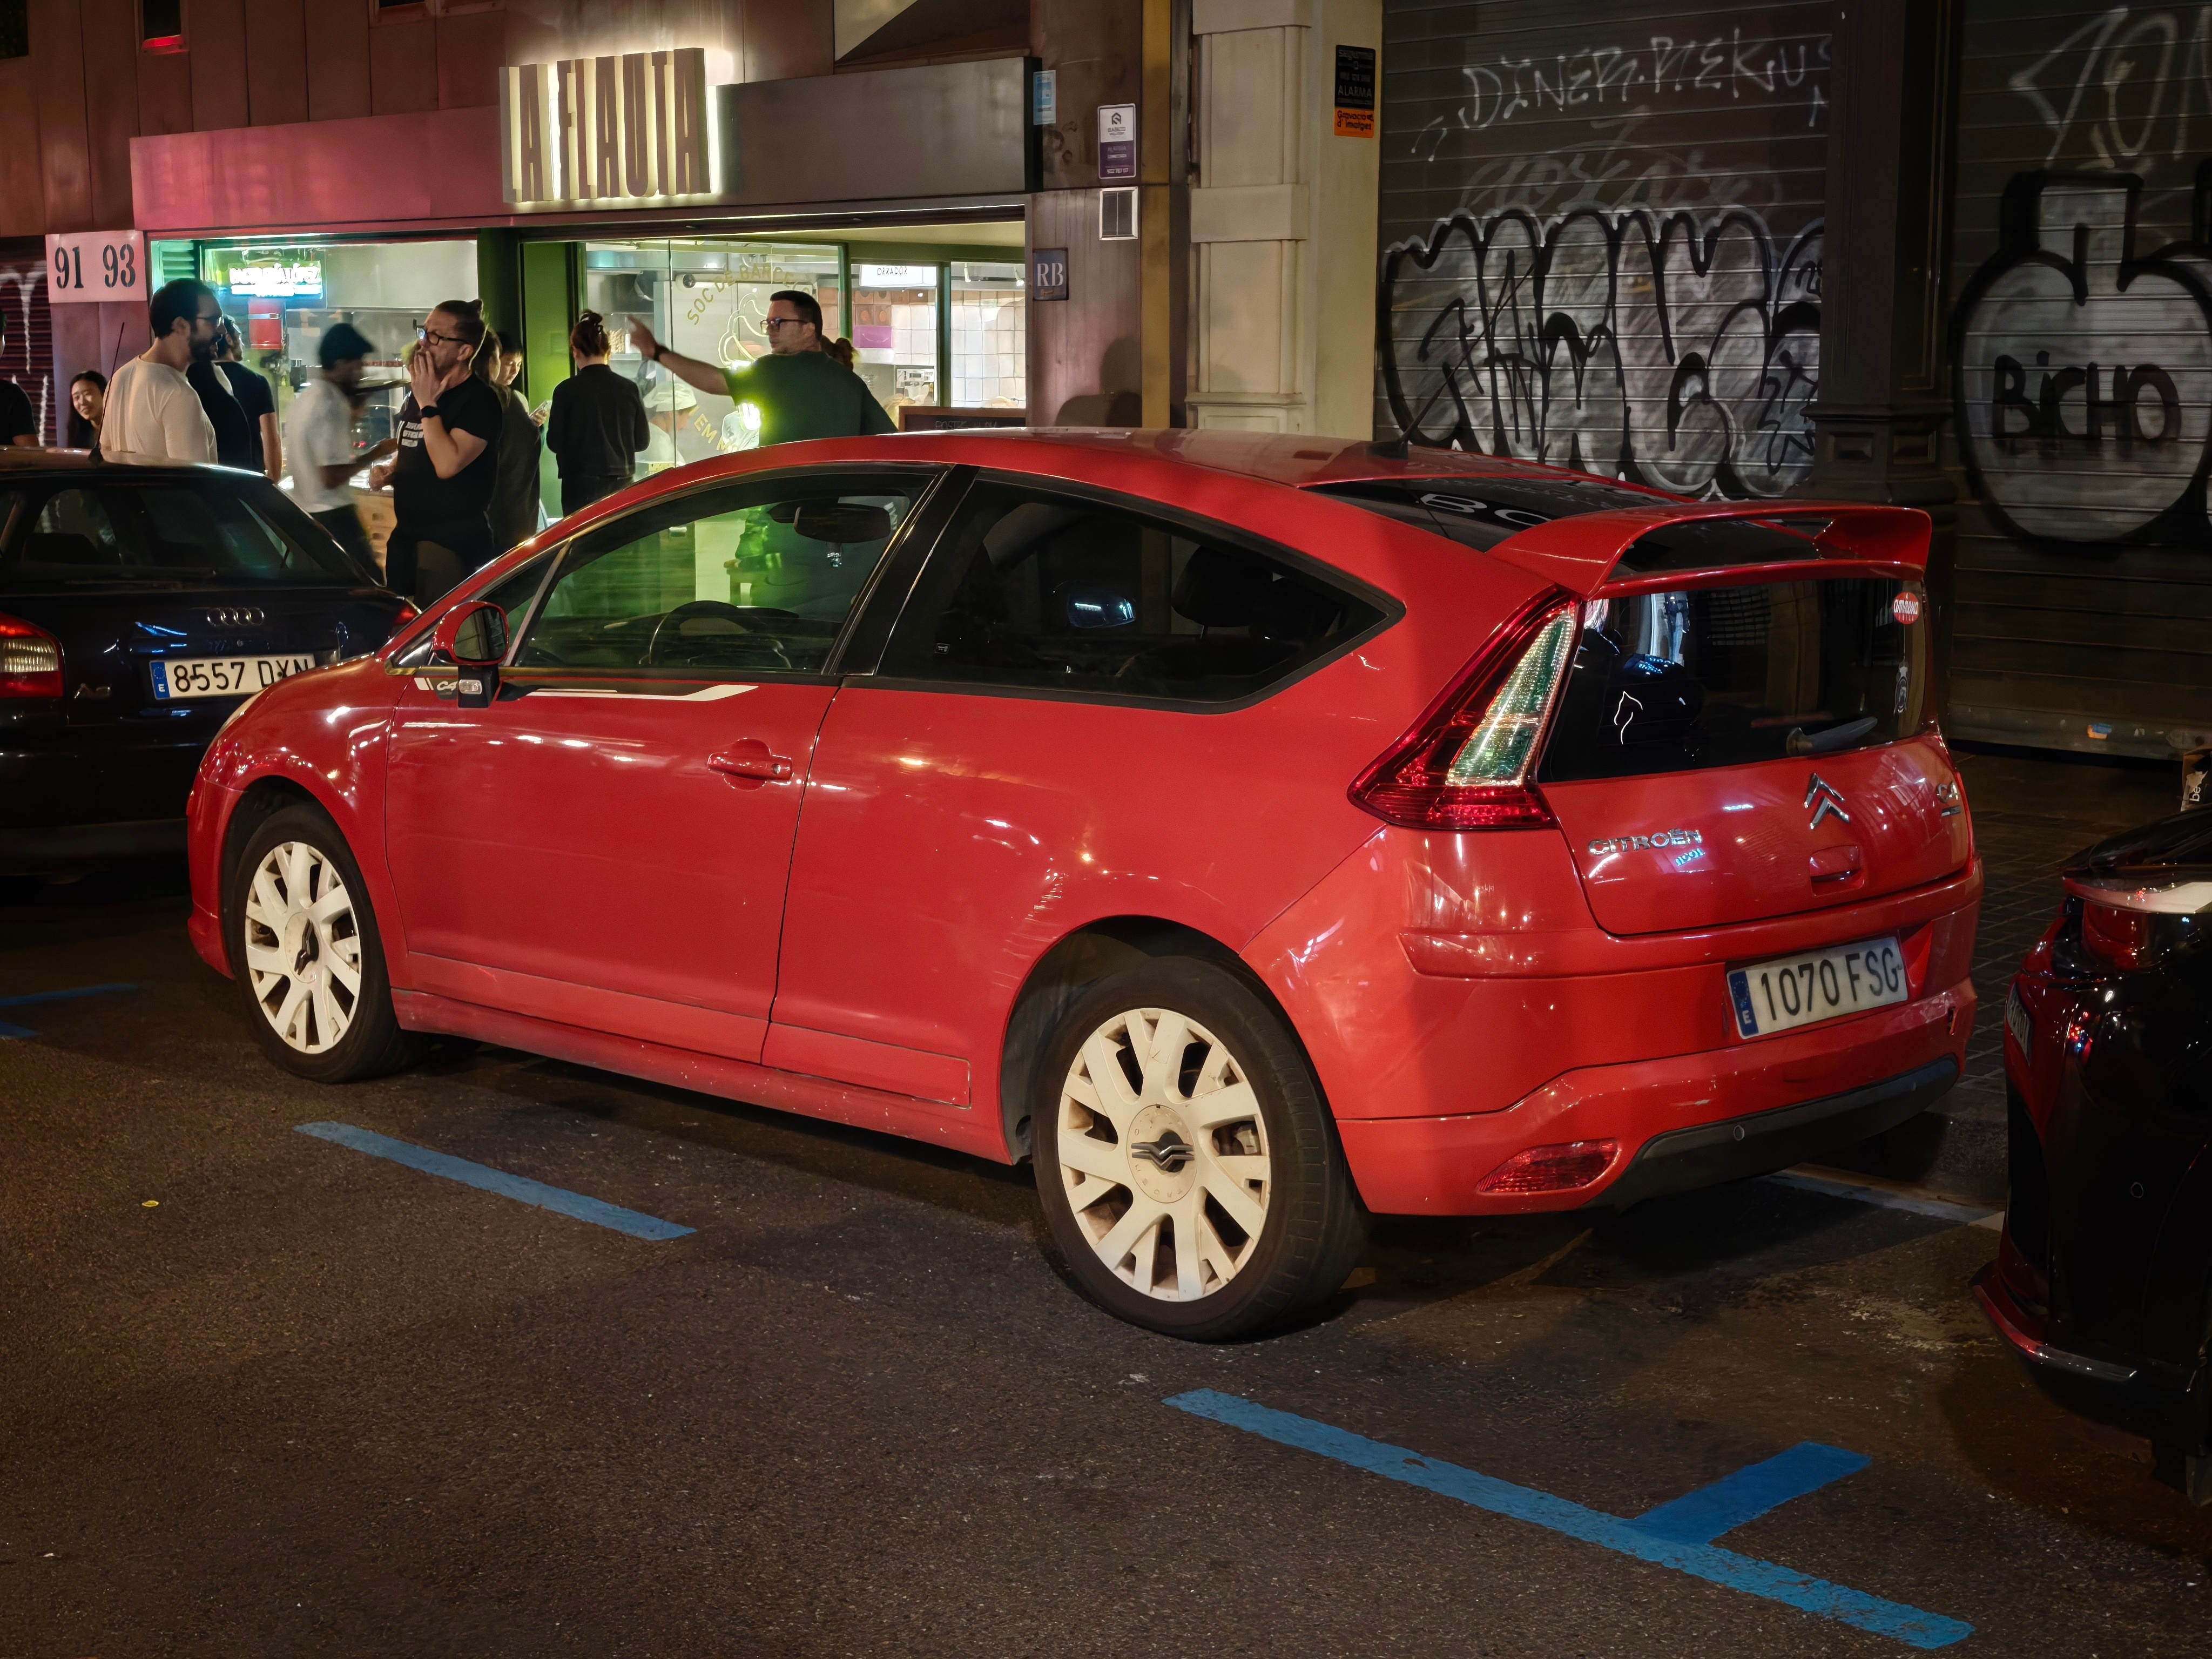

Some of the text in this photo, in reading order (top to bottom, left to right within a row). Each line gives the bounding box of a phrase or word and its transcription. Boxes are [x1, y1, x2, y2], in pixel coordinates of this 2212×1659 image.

[1338, 84, 1372, 98] ALARMA
[499, 48, 711, 203] LA FLAUTA
[55, 243, 136, 289] 91 93
[1037, 262, 1064, 287] RB
[687, 287, 713, 325] SOC
[713, 270, 736, 292] DE
[158, 683, 165, 692] E
[173, 661, 245, 692] 8557
[1588, 828, 1703, 855] CITROËN
[1743, 947, 1899, 1025] E 1070 FSG
